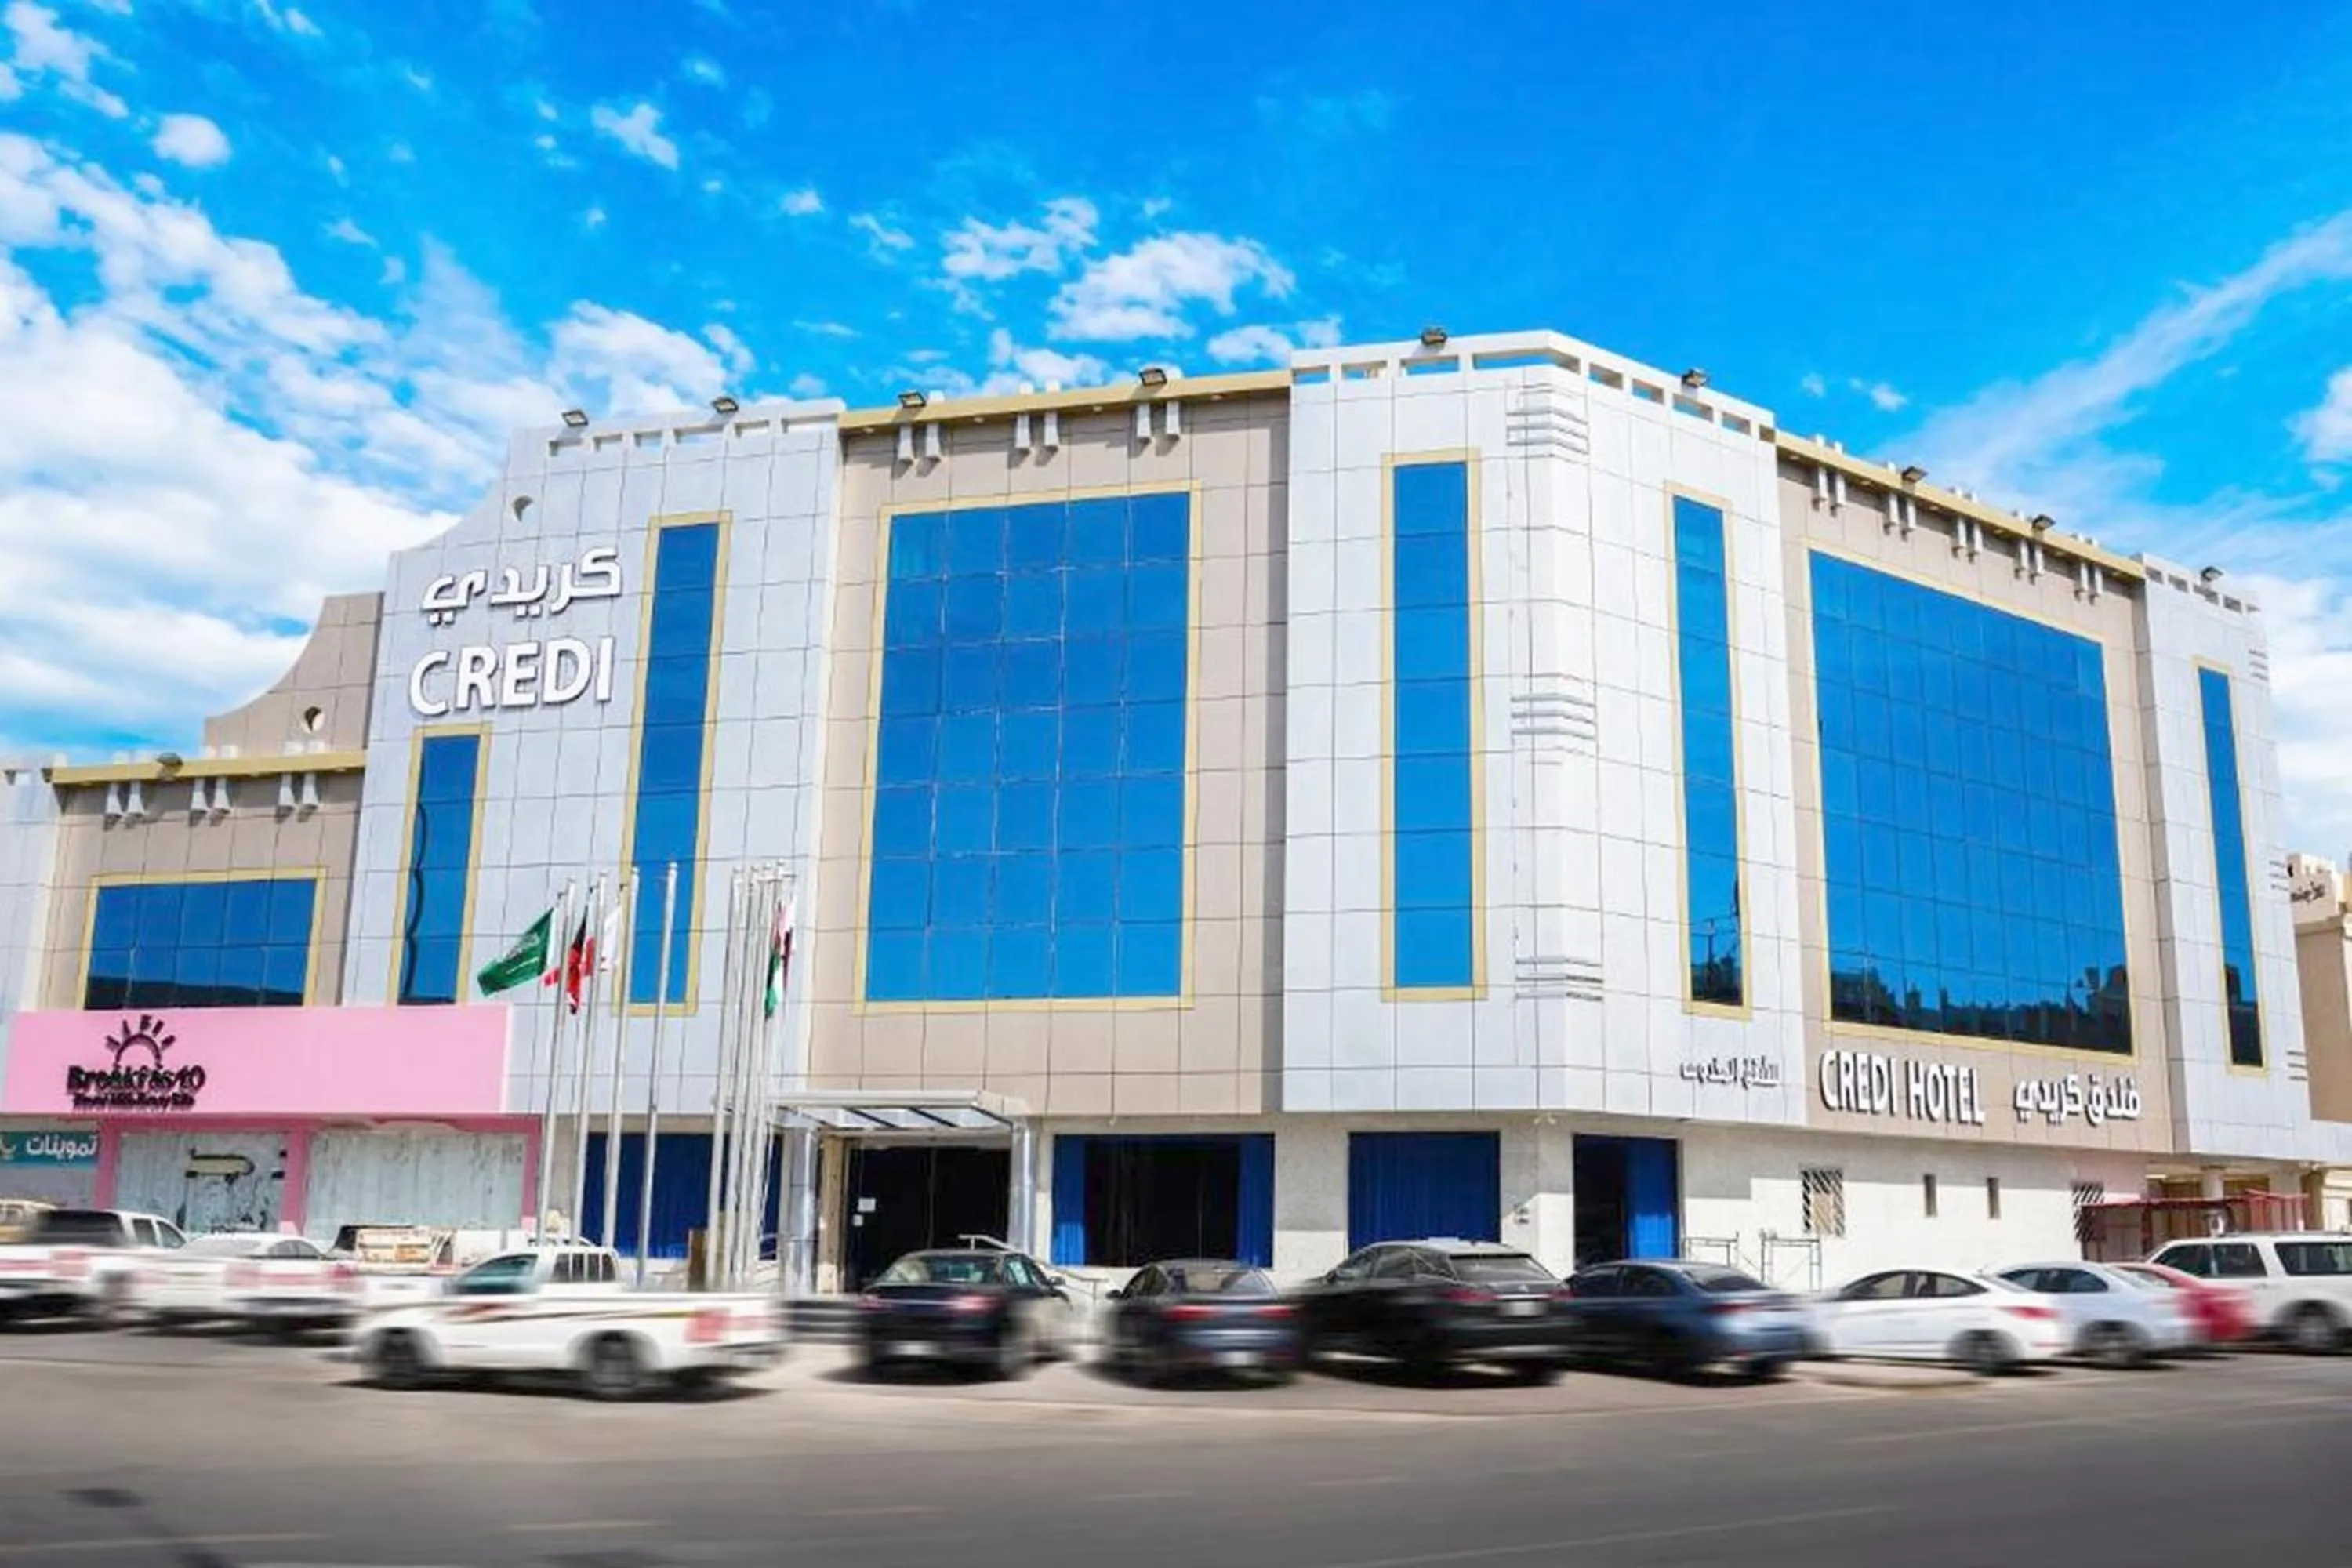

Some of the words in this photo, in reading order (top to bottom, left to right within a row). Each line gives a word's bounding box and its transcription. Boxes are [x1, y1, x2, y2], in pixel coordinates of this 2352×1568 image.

[421, 547, 622, 626] كريدي
[408, 636, 615, 717] CREDI
[1818, 1050, 1898, 1117] CREDI
[1905, 1060, 1986, 1127] HOTEL
[2013, 1074, 2084, 1125] كريدي
[2085, 1074, 2141, 1127] فندق
[26, 1134, 98, 1160] تموينات
